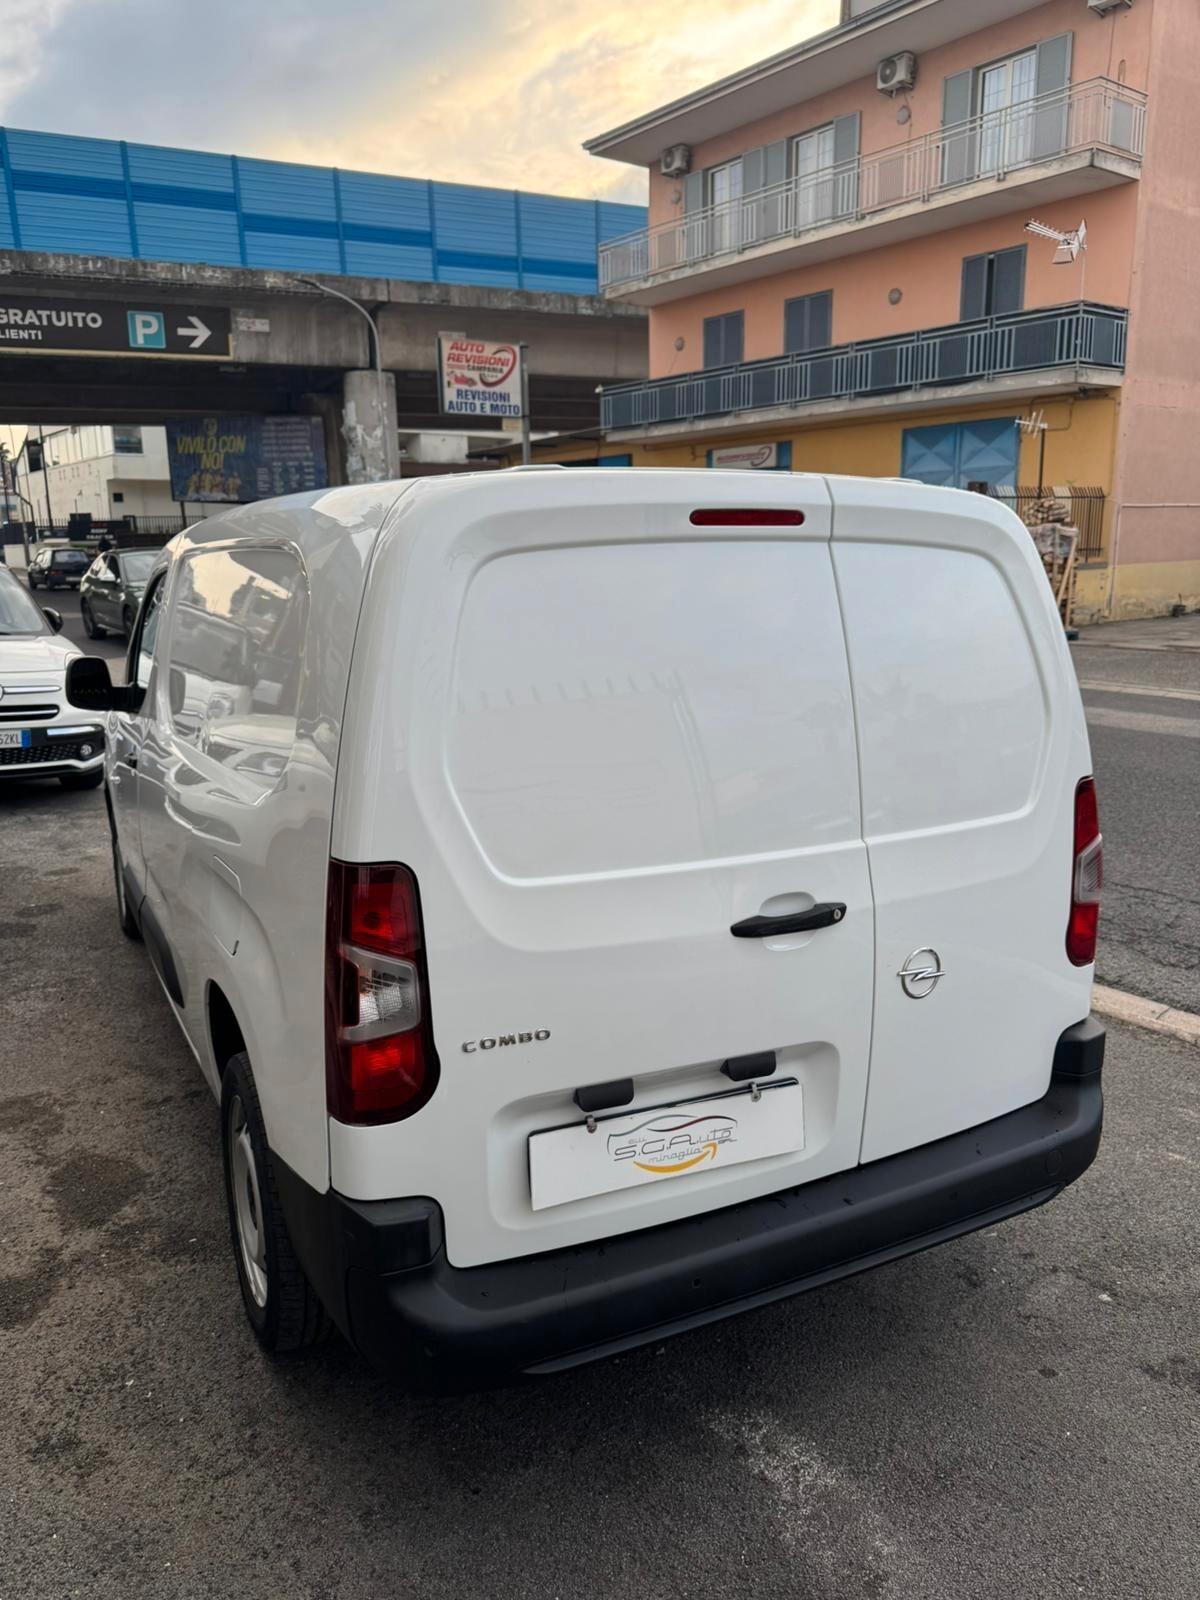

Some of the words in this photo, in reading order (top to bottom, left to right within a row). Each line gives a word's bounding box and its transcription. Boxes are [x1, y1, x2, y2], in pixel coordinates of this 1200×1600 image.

[0, 308, 103, 328] GRATUITO
[136, 314, 159, 344] P
[449, 341, 485, 353] AUTO
[447, 352, 511, 367] REVISIONI
[456, 389, 511, 402] REVISIONI
[447, 401, 477, 412] AUTO
[480, 403, 487, 413] E
[490, 403, 520, 415] MOTO
[219, 435, 246, 453] CON
[201, 452, 224, 470] NOI
[461, 1029, 551, 1053] COMBO
